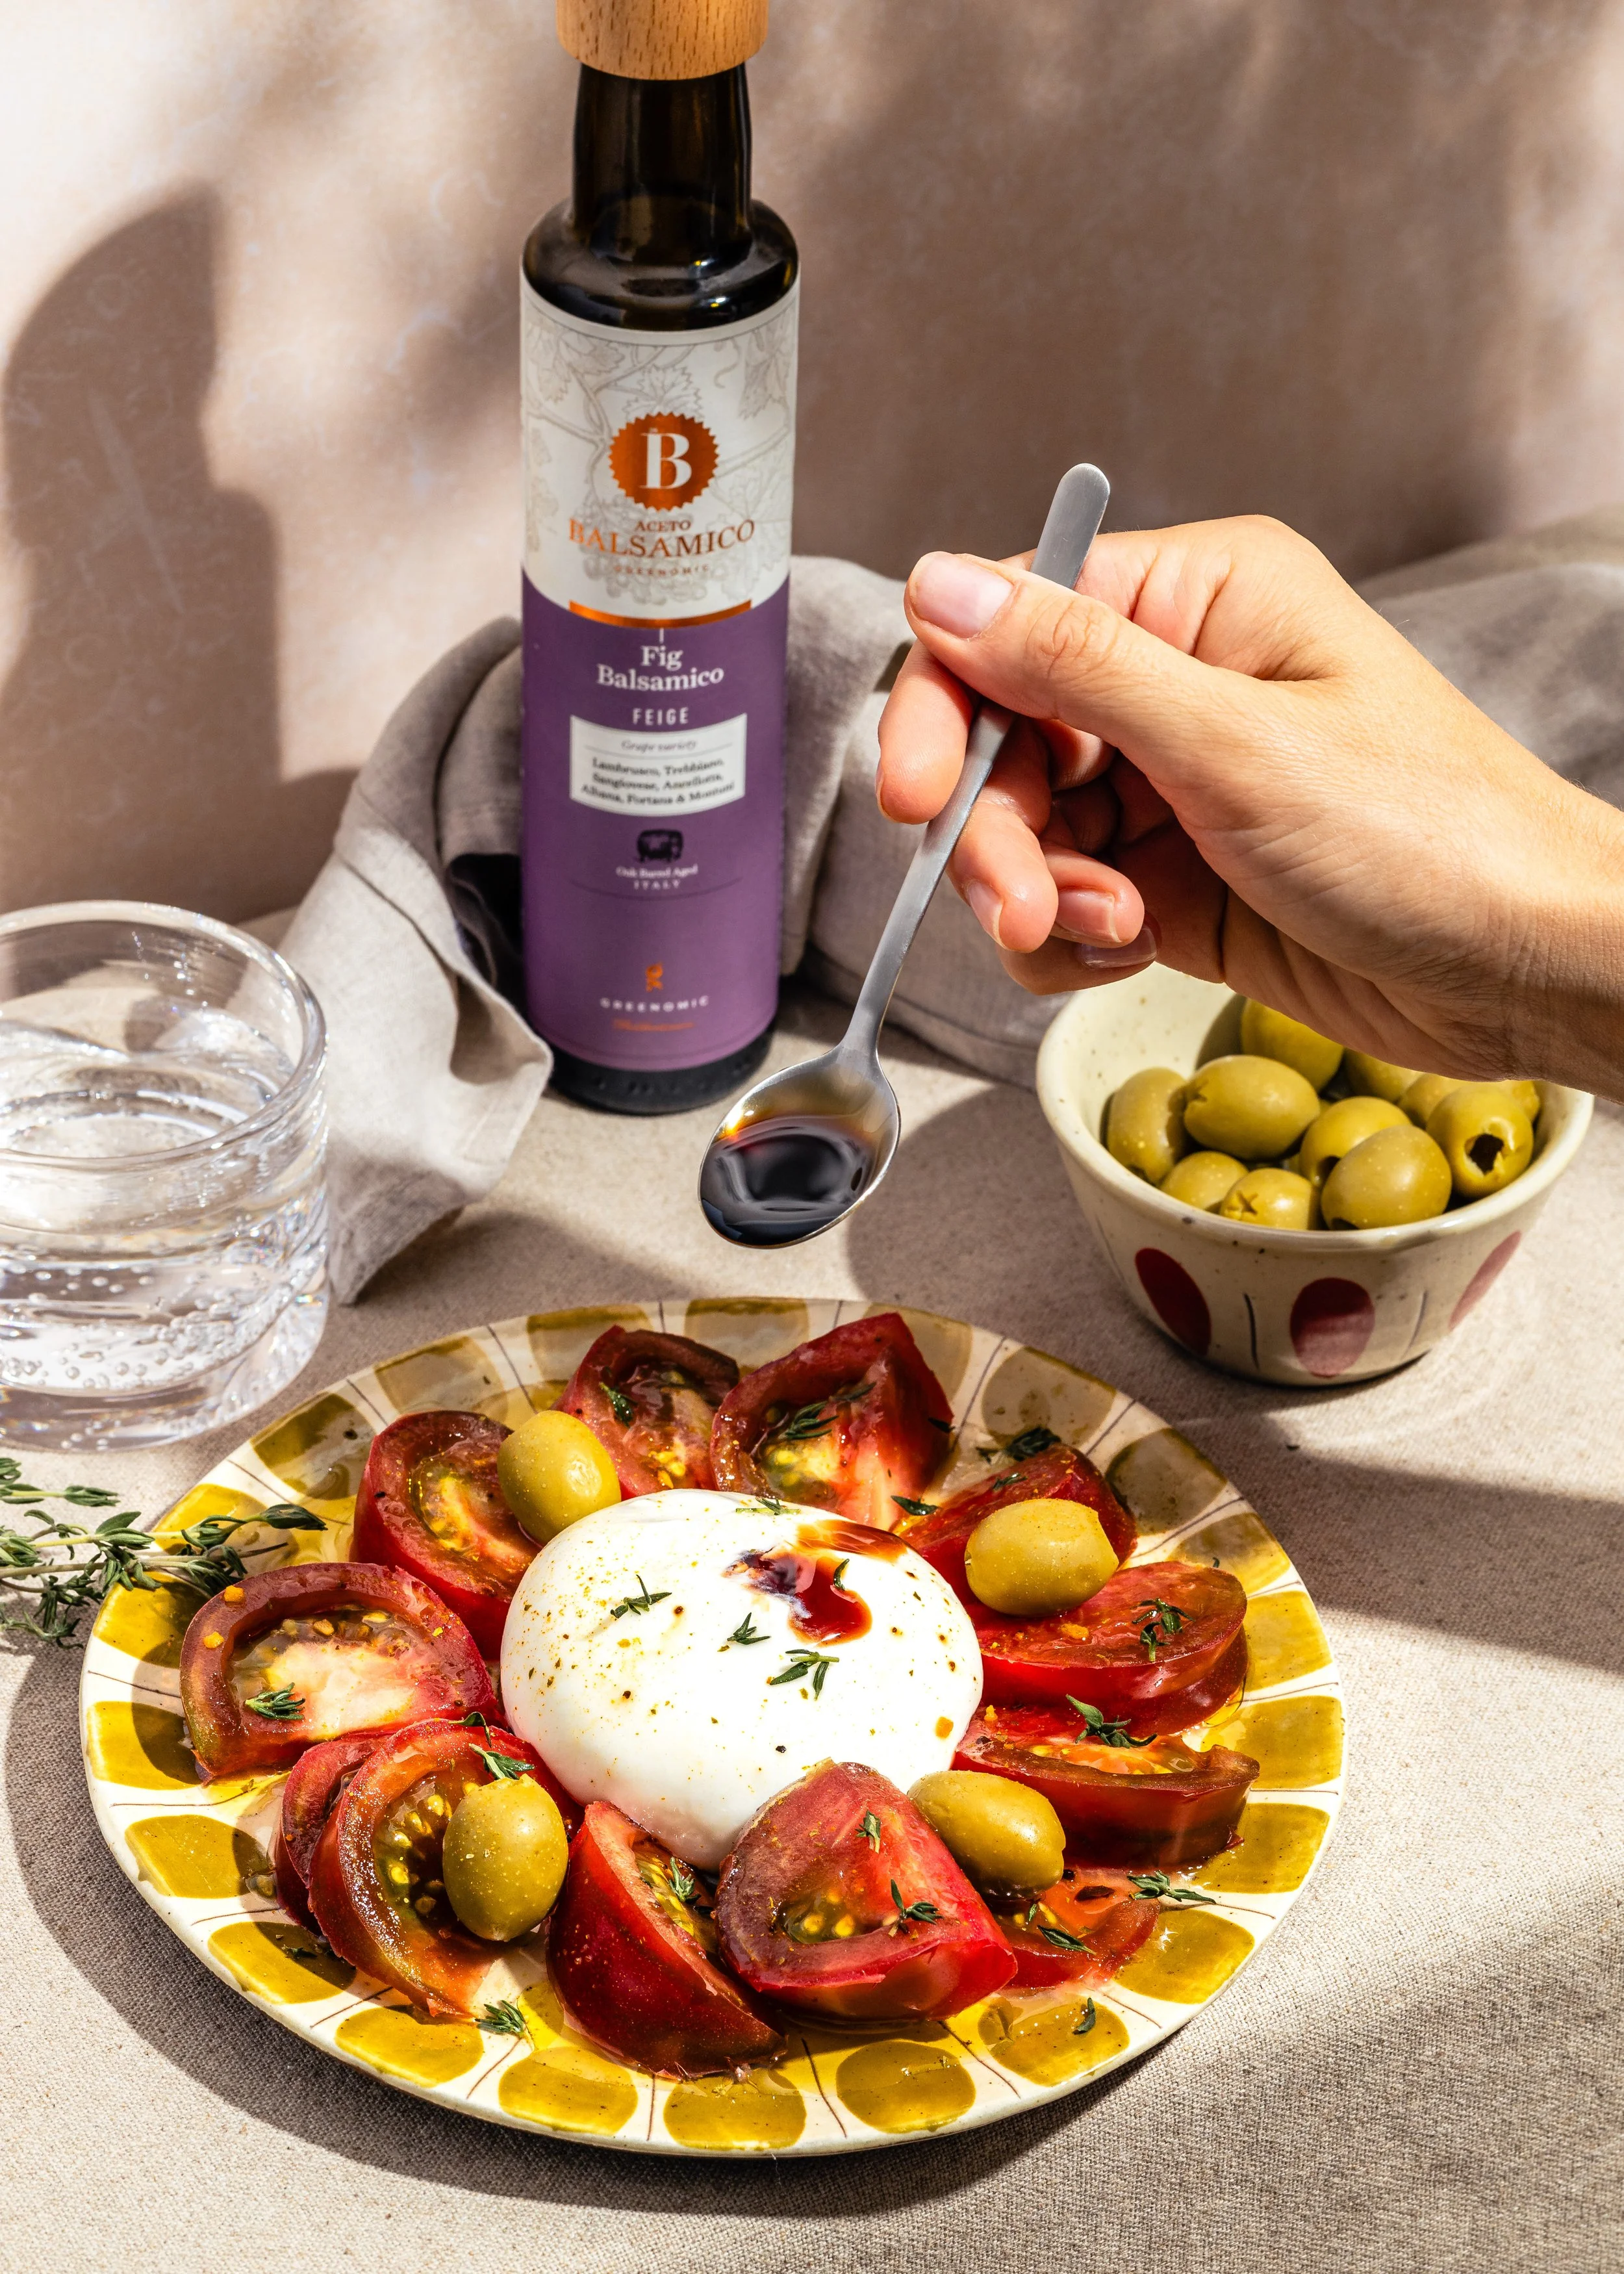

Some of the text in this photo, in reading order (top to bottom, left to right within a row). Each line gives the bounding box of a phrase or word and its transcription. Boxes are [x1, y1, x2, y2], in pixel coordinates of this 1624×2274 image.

[639, 428, 692, 490] B
[635, 520, 692, 532] ACETO
[568, 517, 755, 559] BALSAMICO
[641, 645, 683, 671] Fig
[597, 663, 724, 692] Balsamico
[632, 707, 689, 726] FEIGE
[621, 739, 697, 754] Grape variety
[676, 793, 685, 803] &
[673, 863, 698, 878] Aged
[633, 879, 680, 890] ITALY
[600, 995, 709, 1013] GREENOMIC
